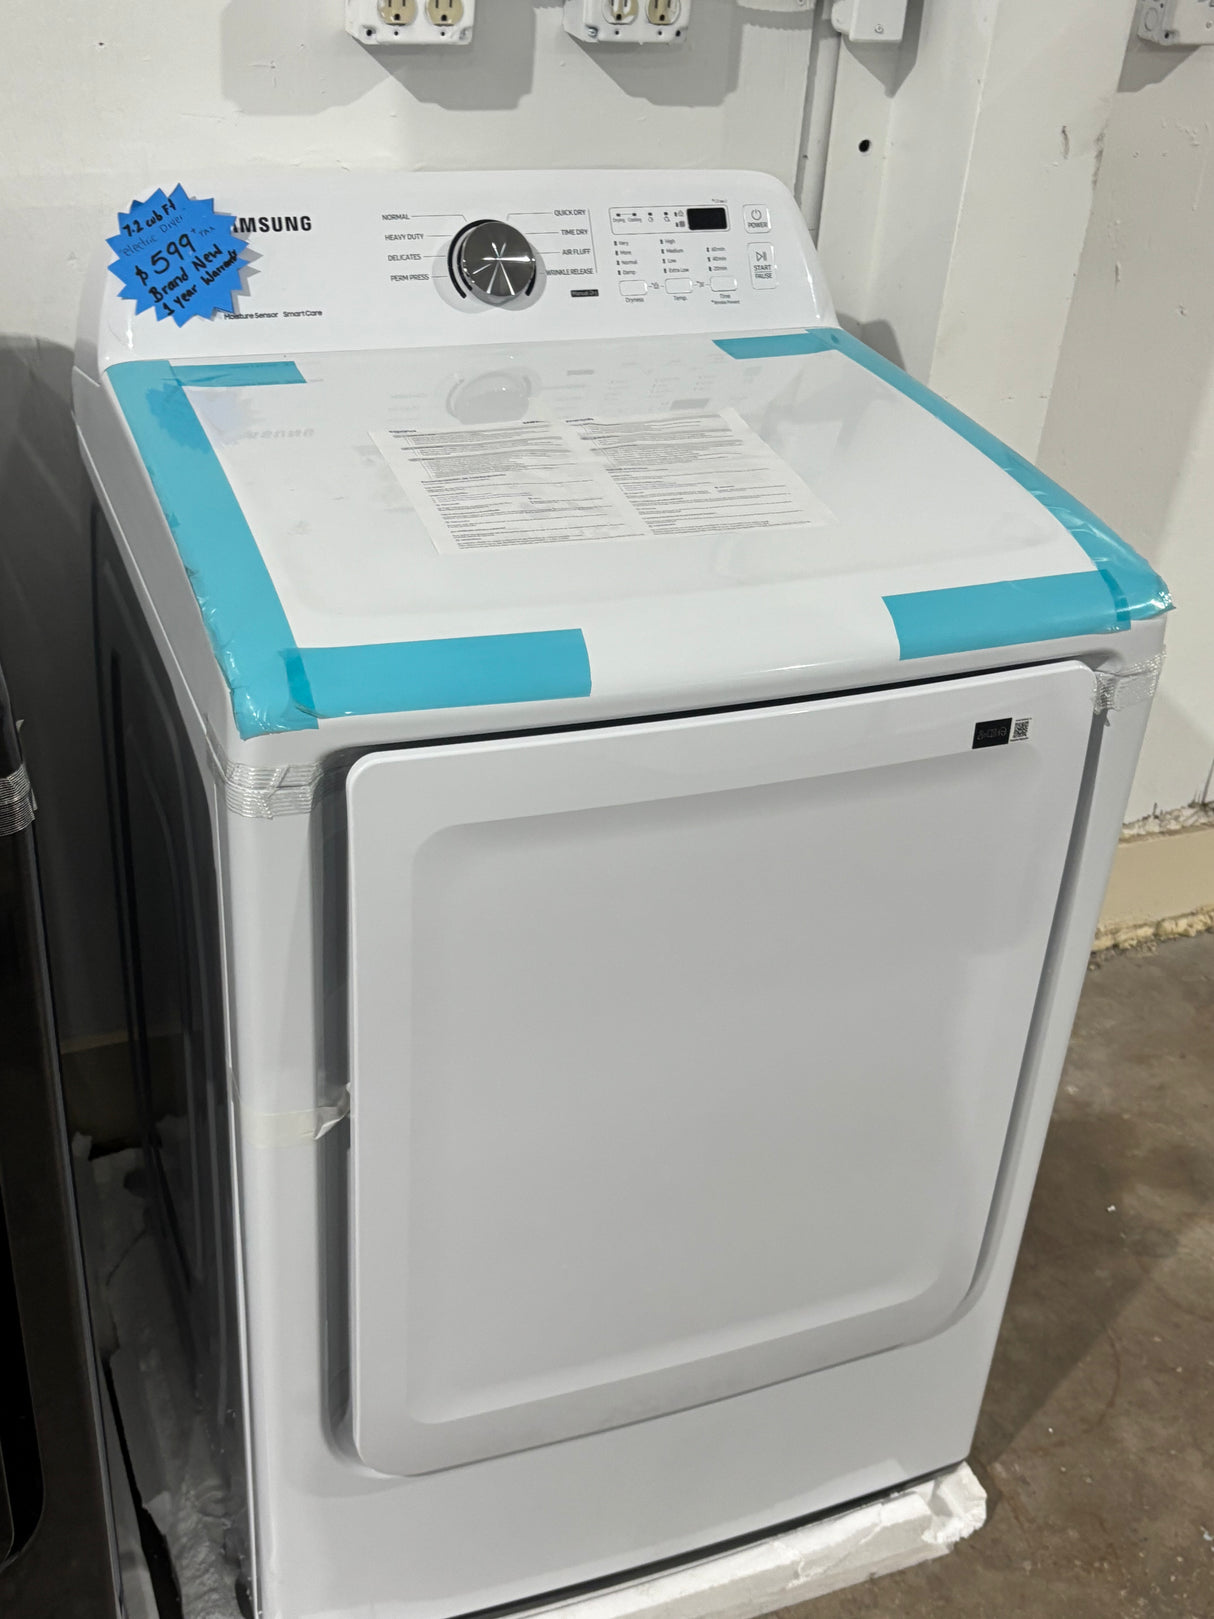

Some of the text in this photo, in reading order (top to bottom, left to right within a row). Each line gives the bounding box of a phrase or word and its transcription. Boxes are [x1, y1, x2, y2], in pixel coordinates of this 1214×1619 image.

[554, 209, 573, 217] QUICK
[122, 219, 144, 237] 7.2
[747, 221, 768, 229] POWER
[387, 253, 422, 262] DELICATES
[148, 243, 223, 303] Brand New
[409, 273, 430, 281] PRESS
[754, 272, 773, 280] PAUSE
